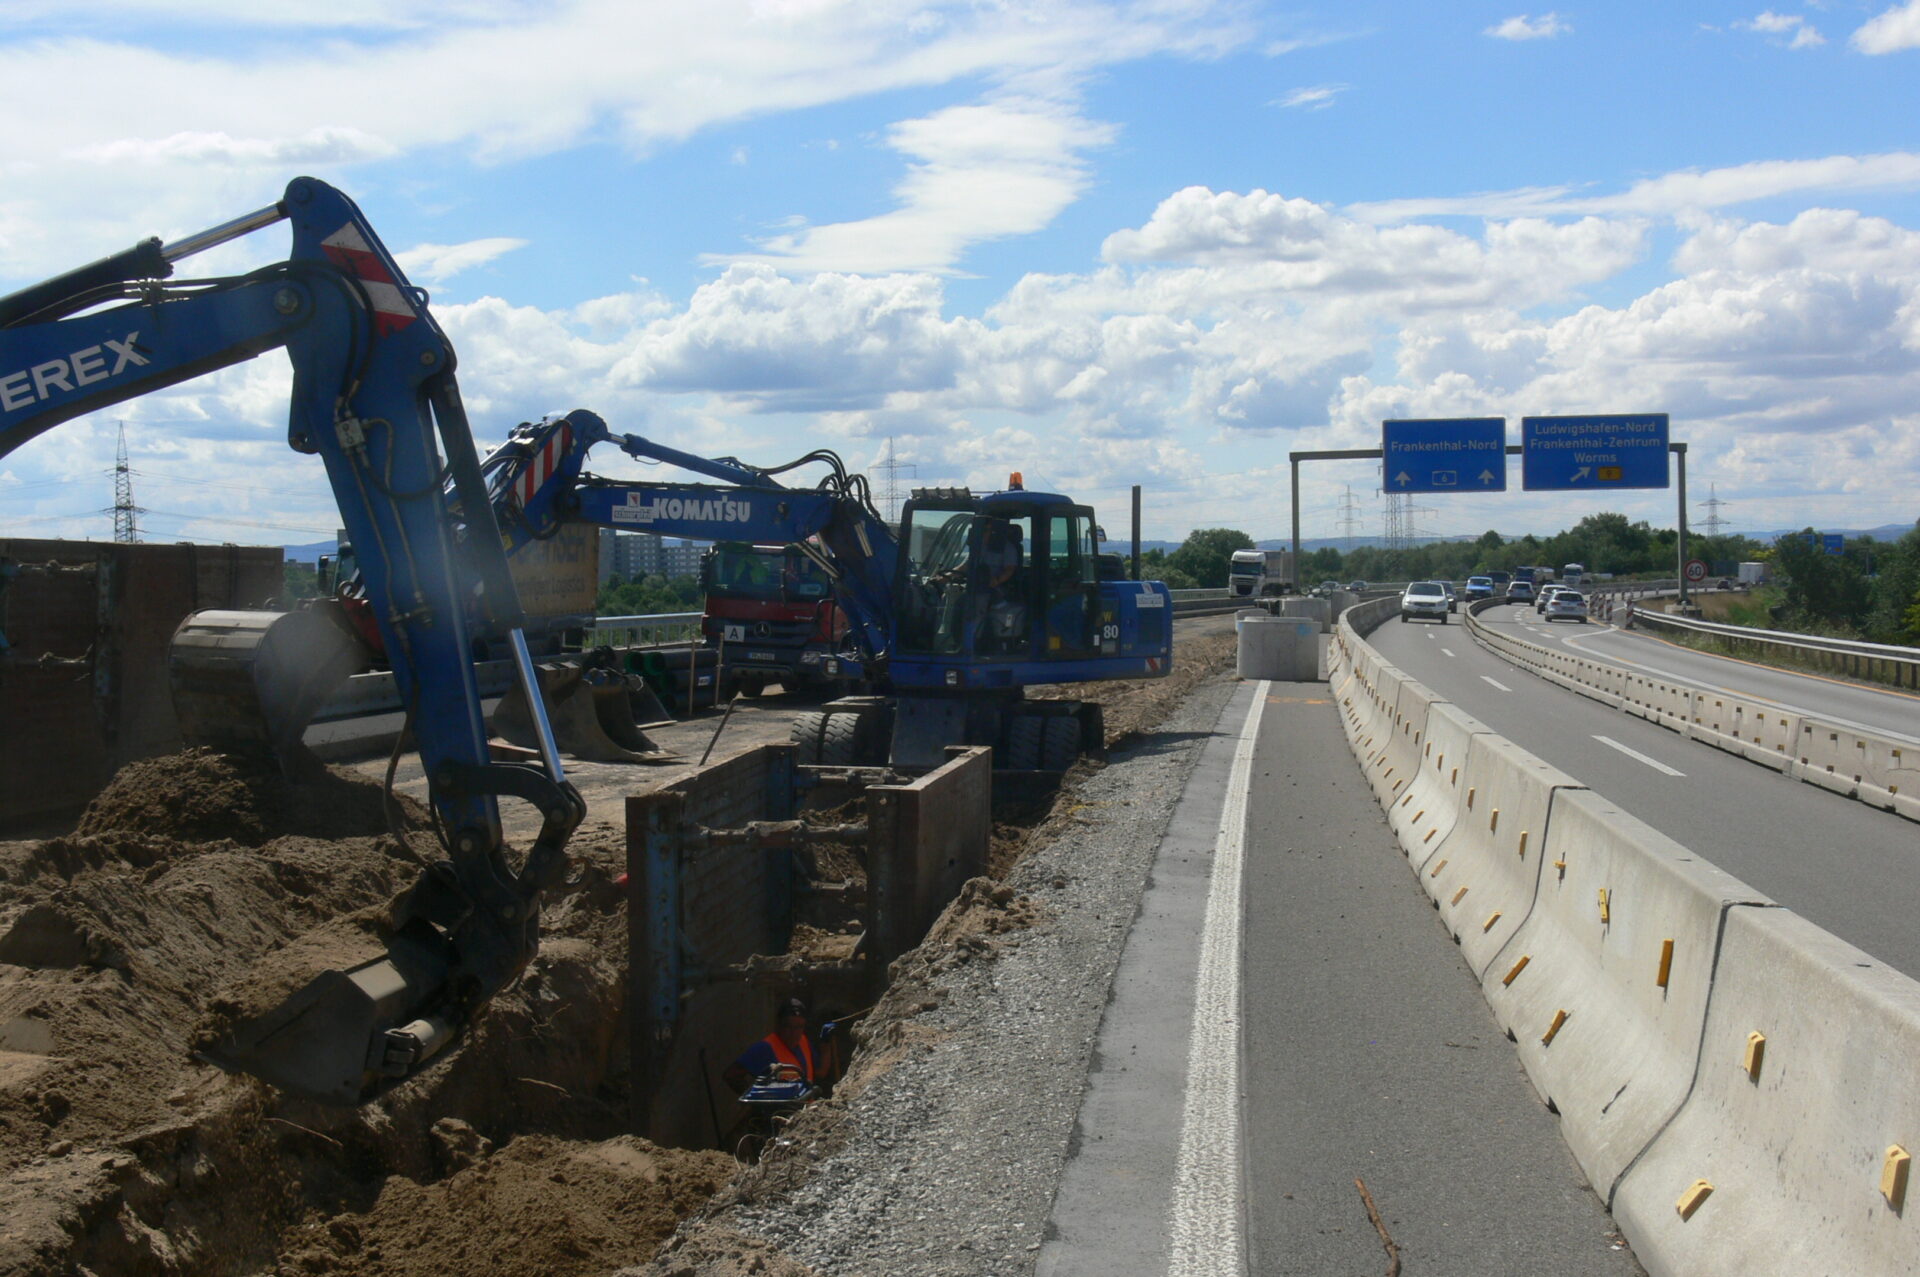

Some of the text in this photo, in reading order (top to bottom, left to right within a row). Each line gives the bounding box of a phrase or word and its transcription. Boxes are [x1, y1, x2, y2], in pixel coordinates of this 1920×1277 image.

[0, 331, 151, 412] EREX
[1535, 421, 1656, 436] Ludwigshafen-Nord
[1391, 439, 1498, 452] Frankenthal-Nord
[1530, 436, 1660, 449] Frankenthal-Zentrum
[1574, 452, 1617, 463] Worms
[1442, 473, 1448, 482] 6
[653, 495, 751, 523] KOMATSU
[1688, 566, 1702, 577] 60
[729, 627, 740, 640] A
[1103, 624, 1119, 639] 80
